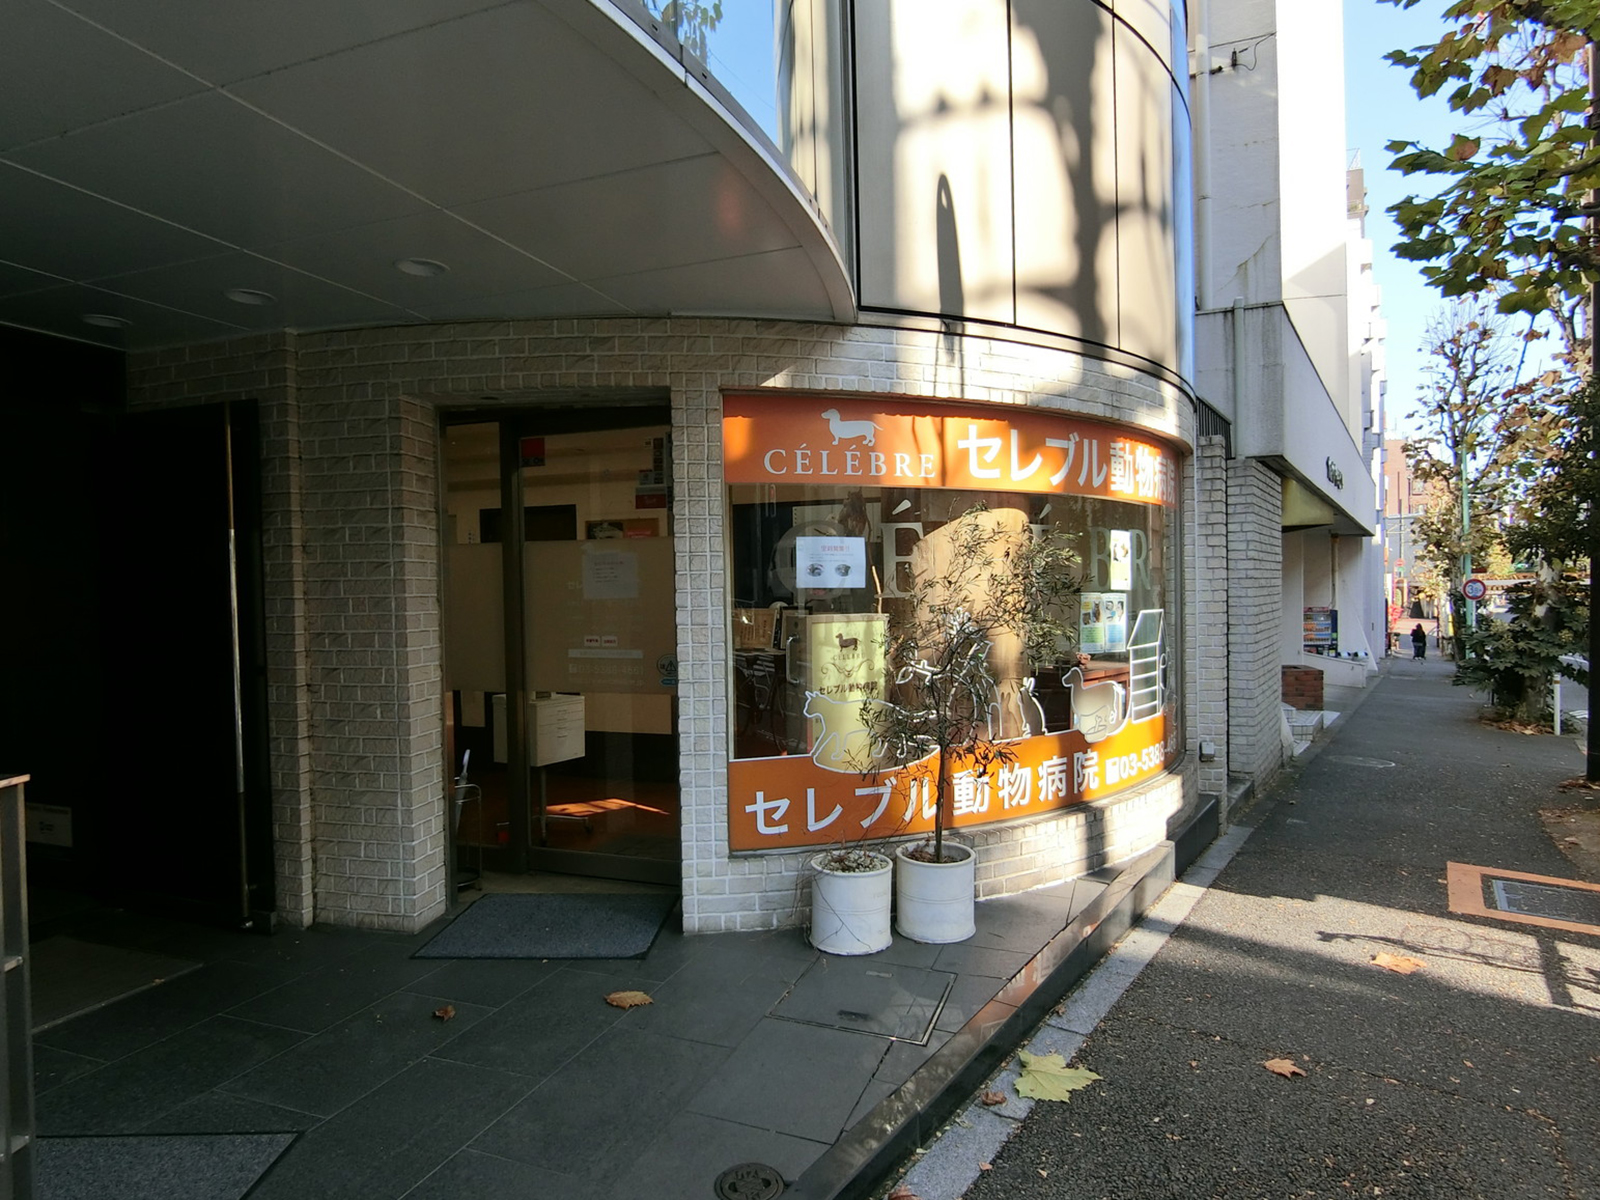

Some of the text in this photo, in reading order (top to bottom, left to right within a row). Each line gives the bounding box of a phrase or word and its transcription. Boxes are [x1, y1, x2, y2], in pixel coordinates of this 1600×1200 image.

[763, 443, 936, 478] CÉLÉBRE
[957, 424, 1176, 504] セレブル動物病院
[744, 749, 1099, 835] セレブル動物病院
